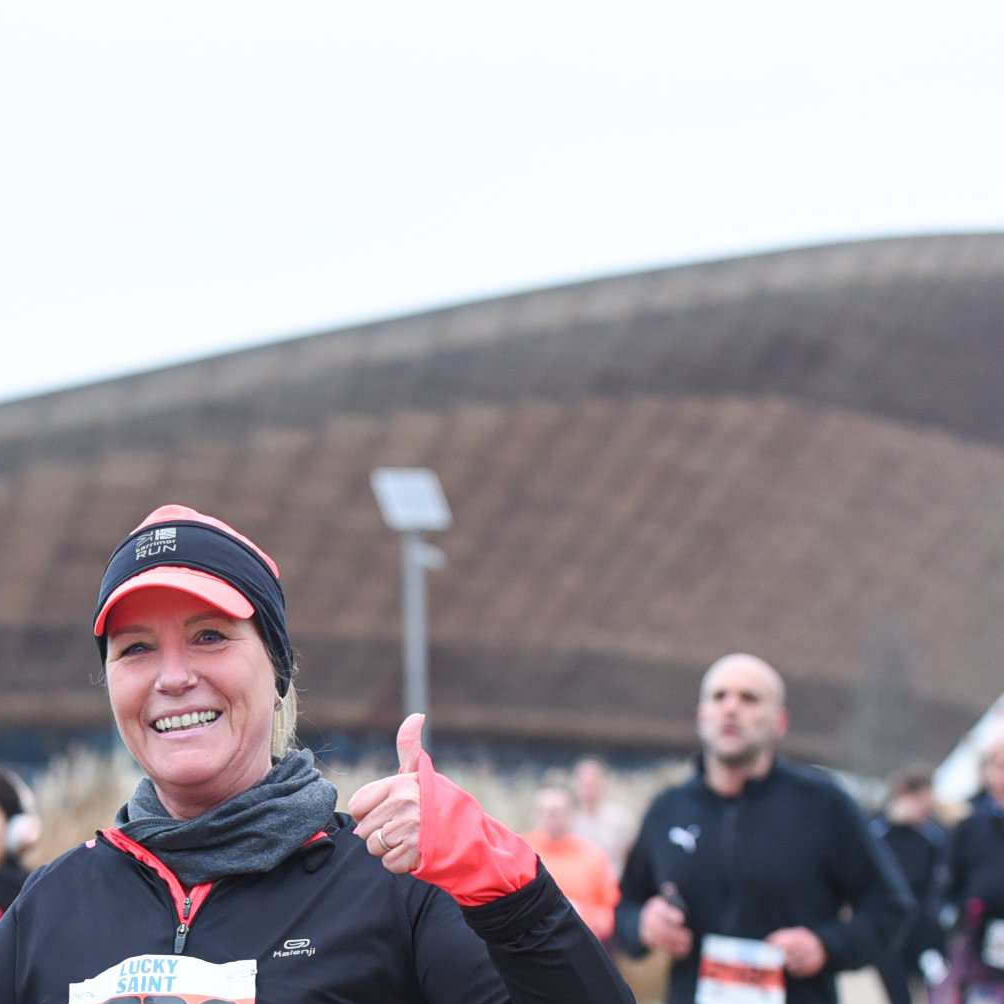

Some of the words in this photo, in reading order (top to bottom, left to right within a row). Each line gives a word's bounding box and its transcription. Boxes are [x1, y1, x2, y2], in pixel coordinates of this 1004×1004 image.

[135, 544, 177, 561] RUN
[119, 958, 180, 977] LUCKY
[115, 975, 178, 994] SAINT
